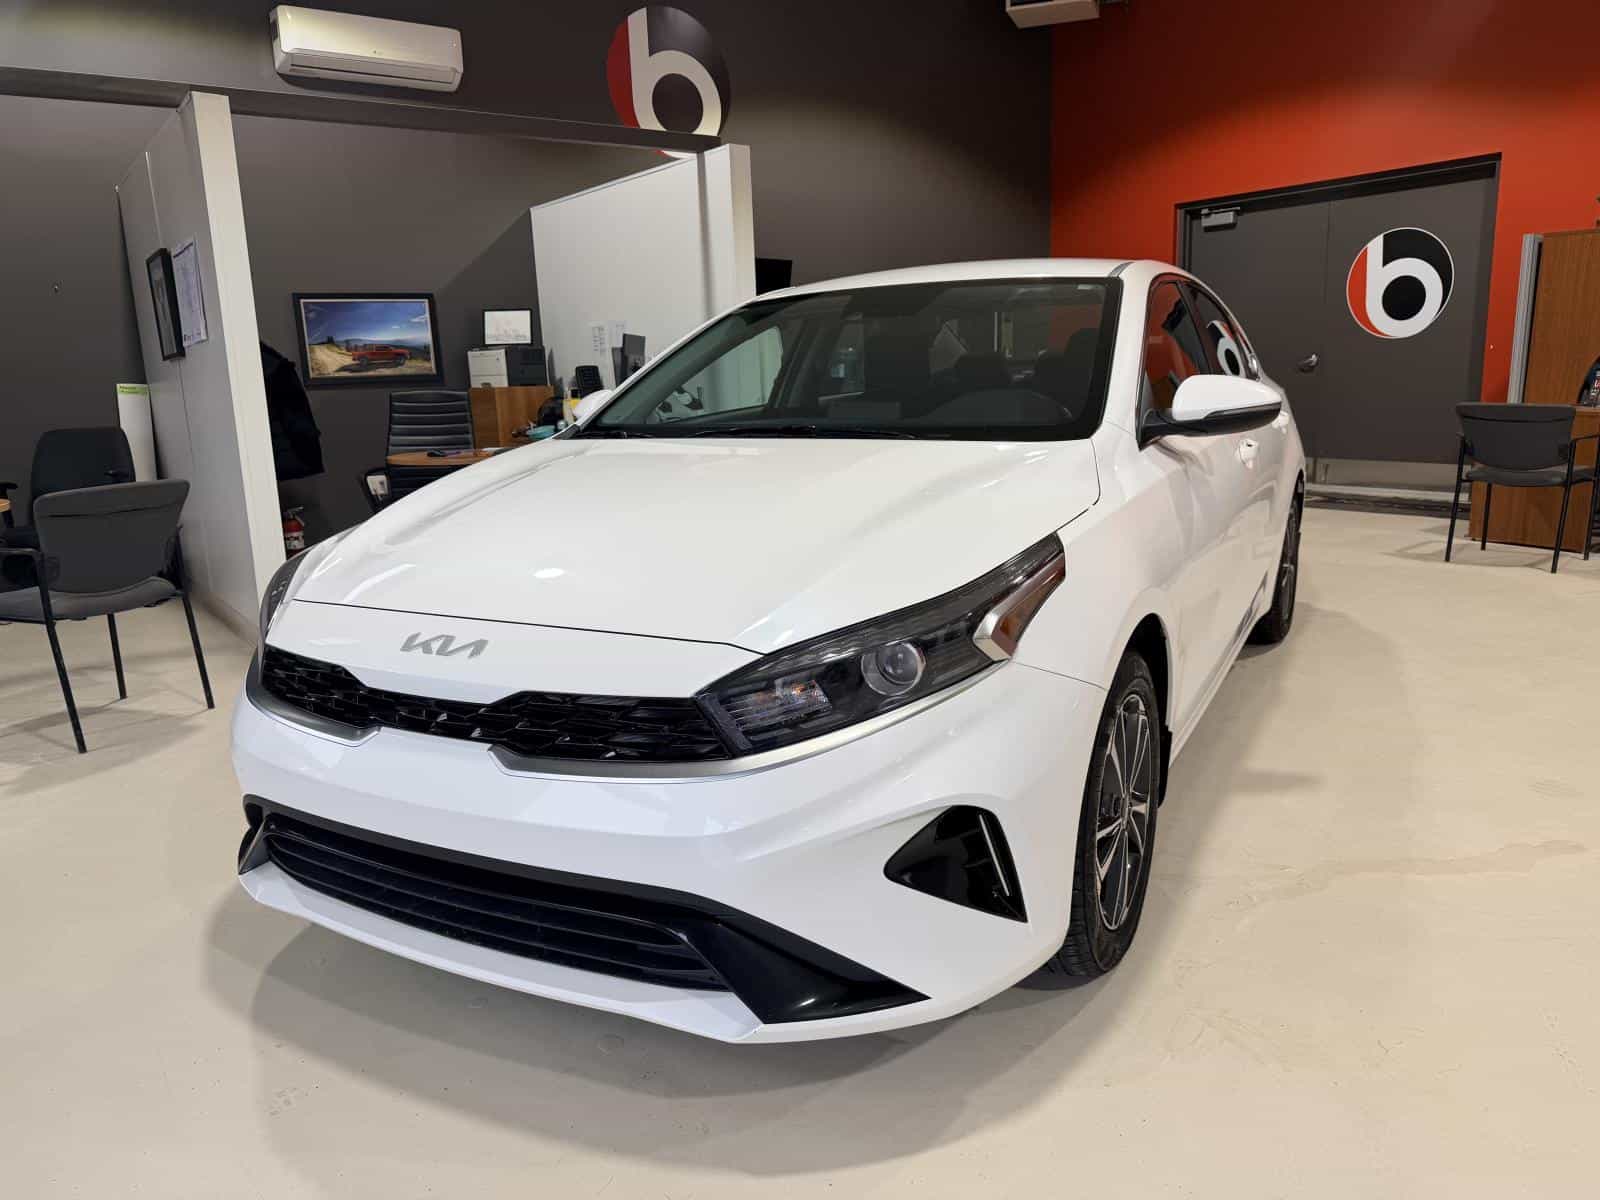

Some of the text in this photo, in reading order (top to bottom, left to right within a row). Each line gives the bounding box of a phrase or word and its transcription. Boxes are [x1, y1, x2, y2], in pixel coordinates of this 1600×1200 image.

[627, 6, 722, 159] b
[1365, 232, 1443, 339] b
[400, 632, 488, 659] KIA
